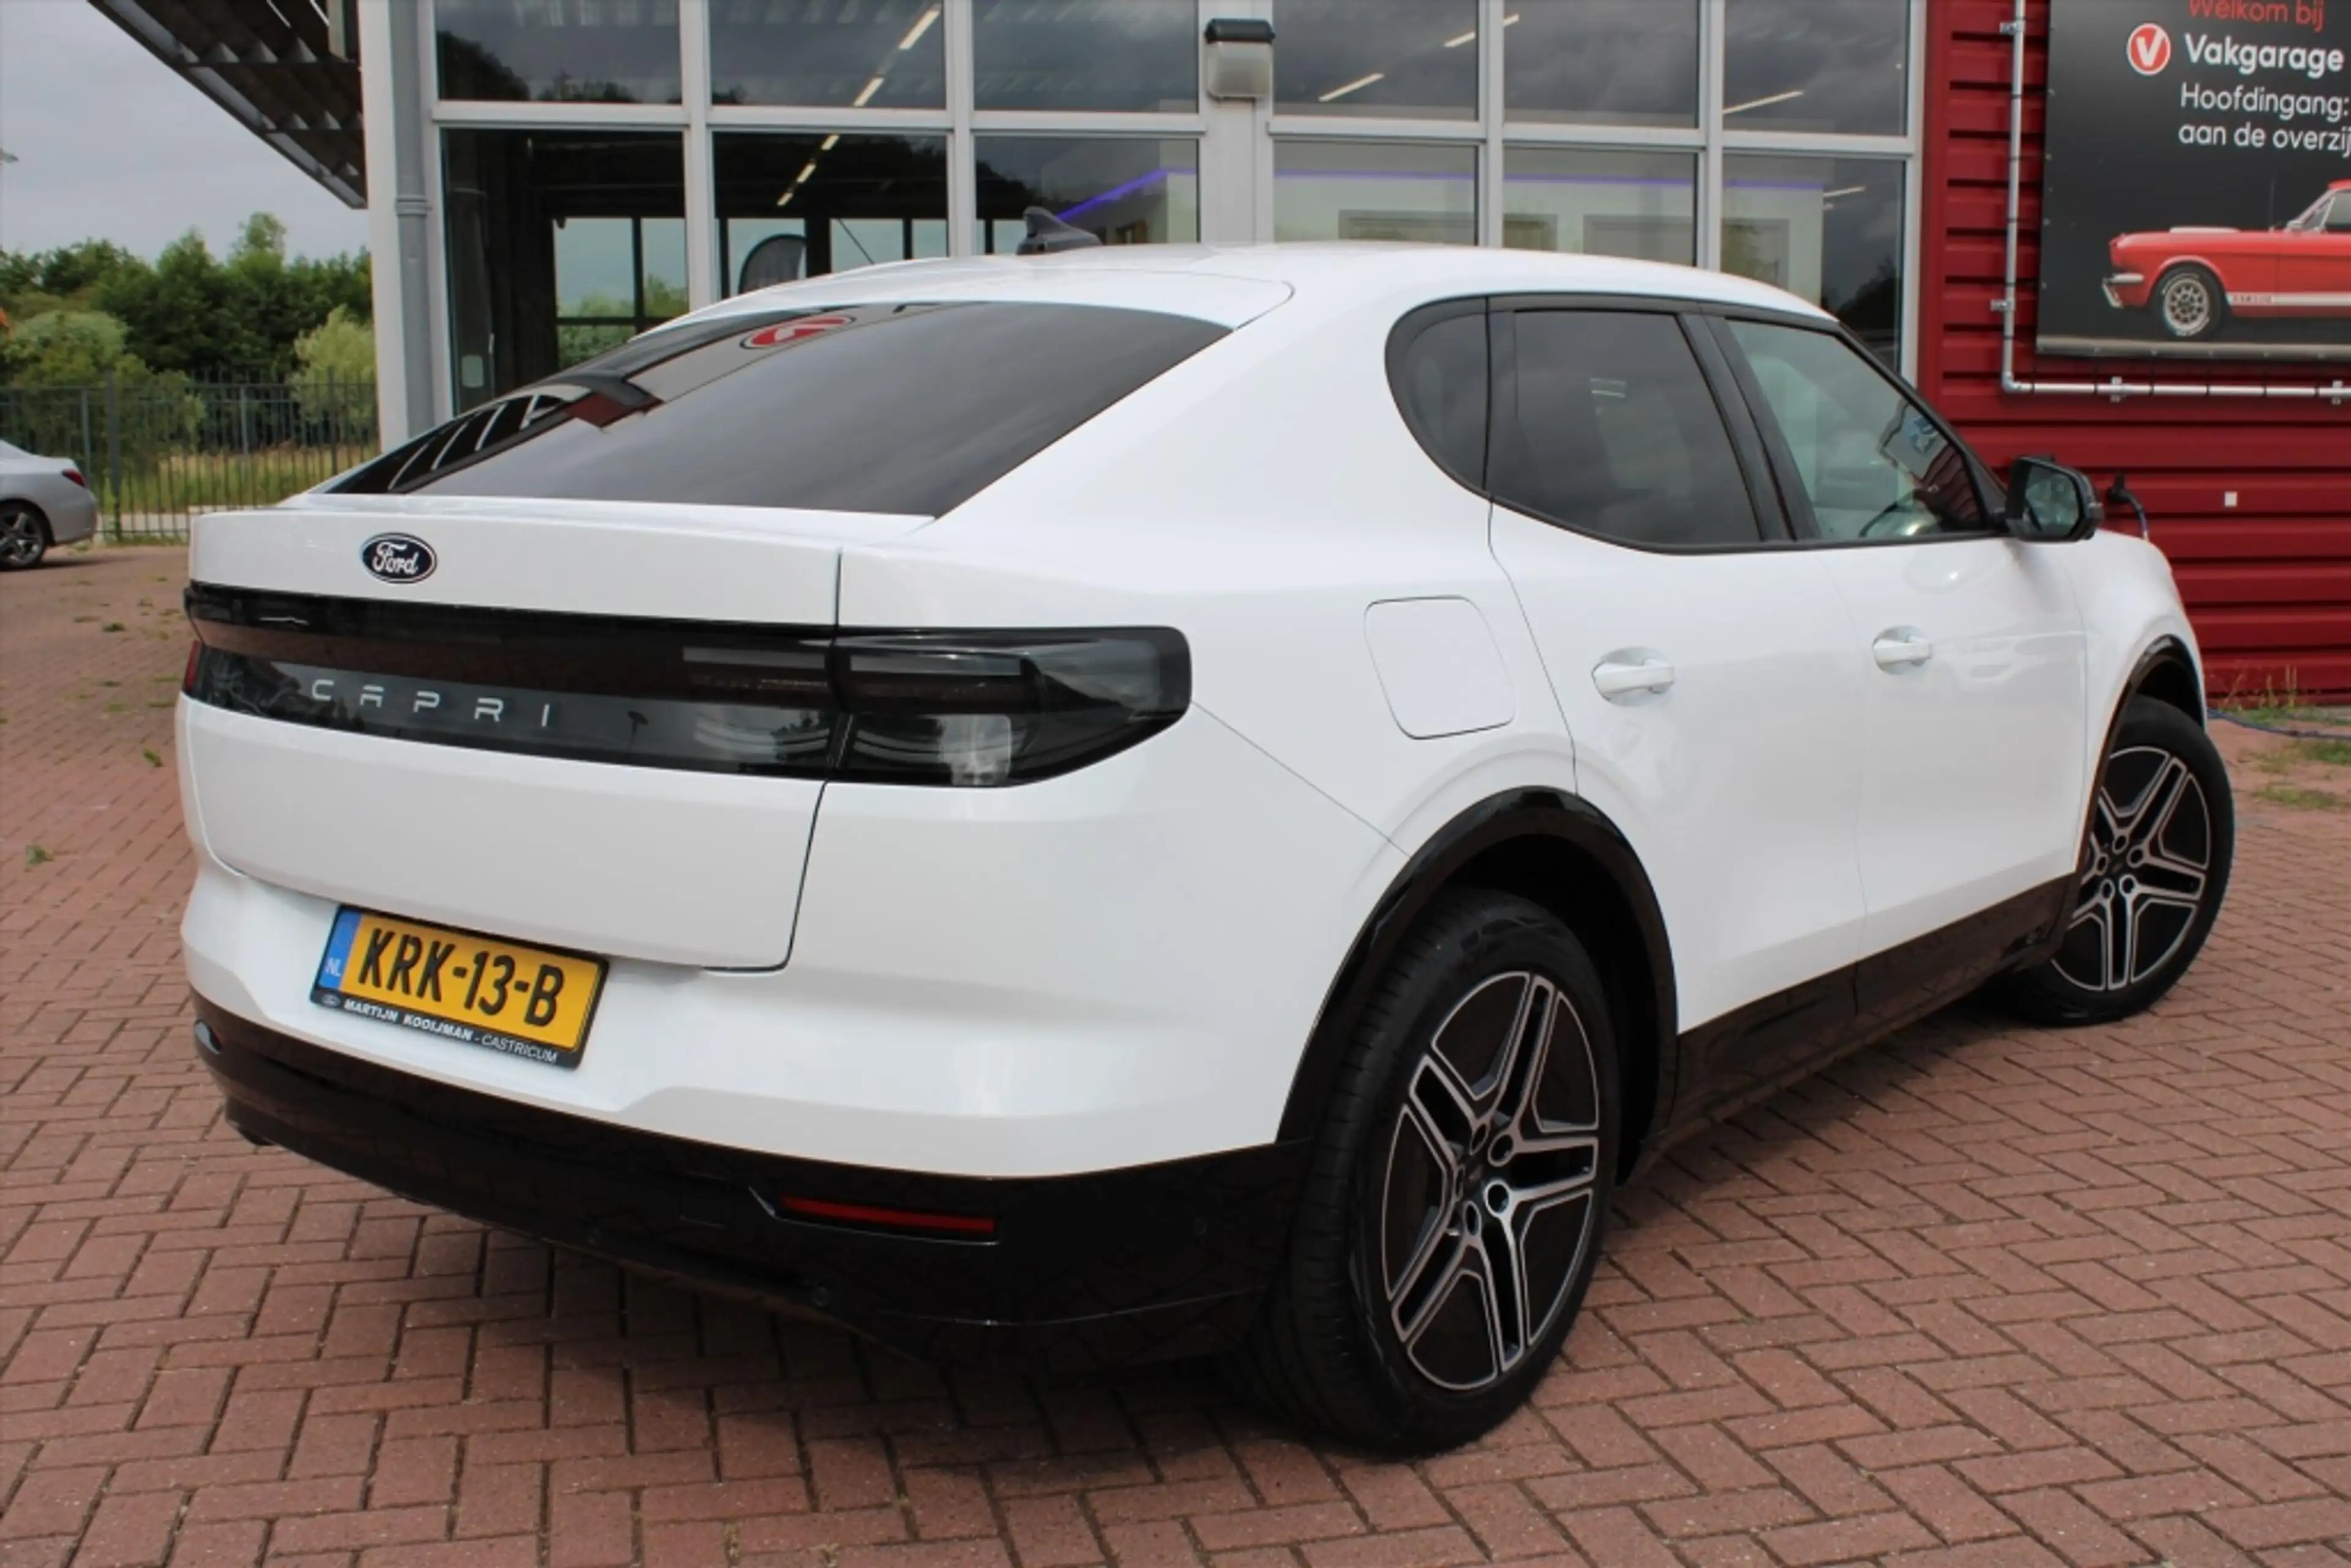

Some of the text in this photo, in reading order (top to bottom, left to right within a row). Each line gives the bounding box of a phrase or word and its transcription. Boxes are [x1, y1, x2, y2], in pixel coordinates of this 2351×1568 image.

[2188, 0, 2288, 23] Welkom
[2184, 32, 2345, 79] Vakgarage
[2180, 81, 2350, 122] Hoofdingang:
[2178, 124, 2227, 146] aan
[2234, 121, 2267, 148] de
[372, 541, 419, 574] Ford
[311, 679, 550, 727] CAPRI
[325, 956, 341, 977] NL
[358, 928, 565, 1027] KRK-13-B
[344, 999, 398, 1022] MARTIJN
[403, 1013, 473, 1042] KOOIJMAN
[481, 1033, 558, 1063] CASTRICUM
